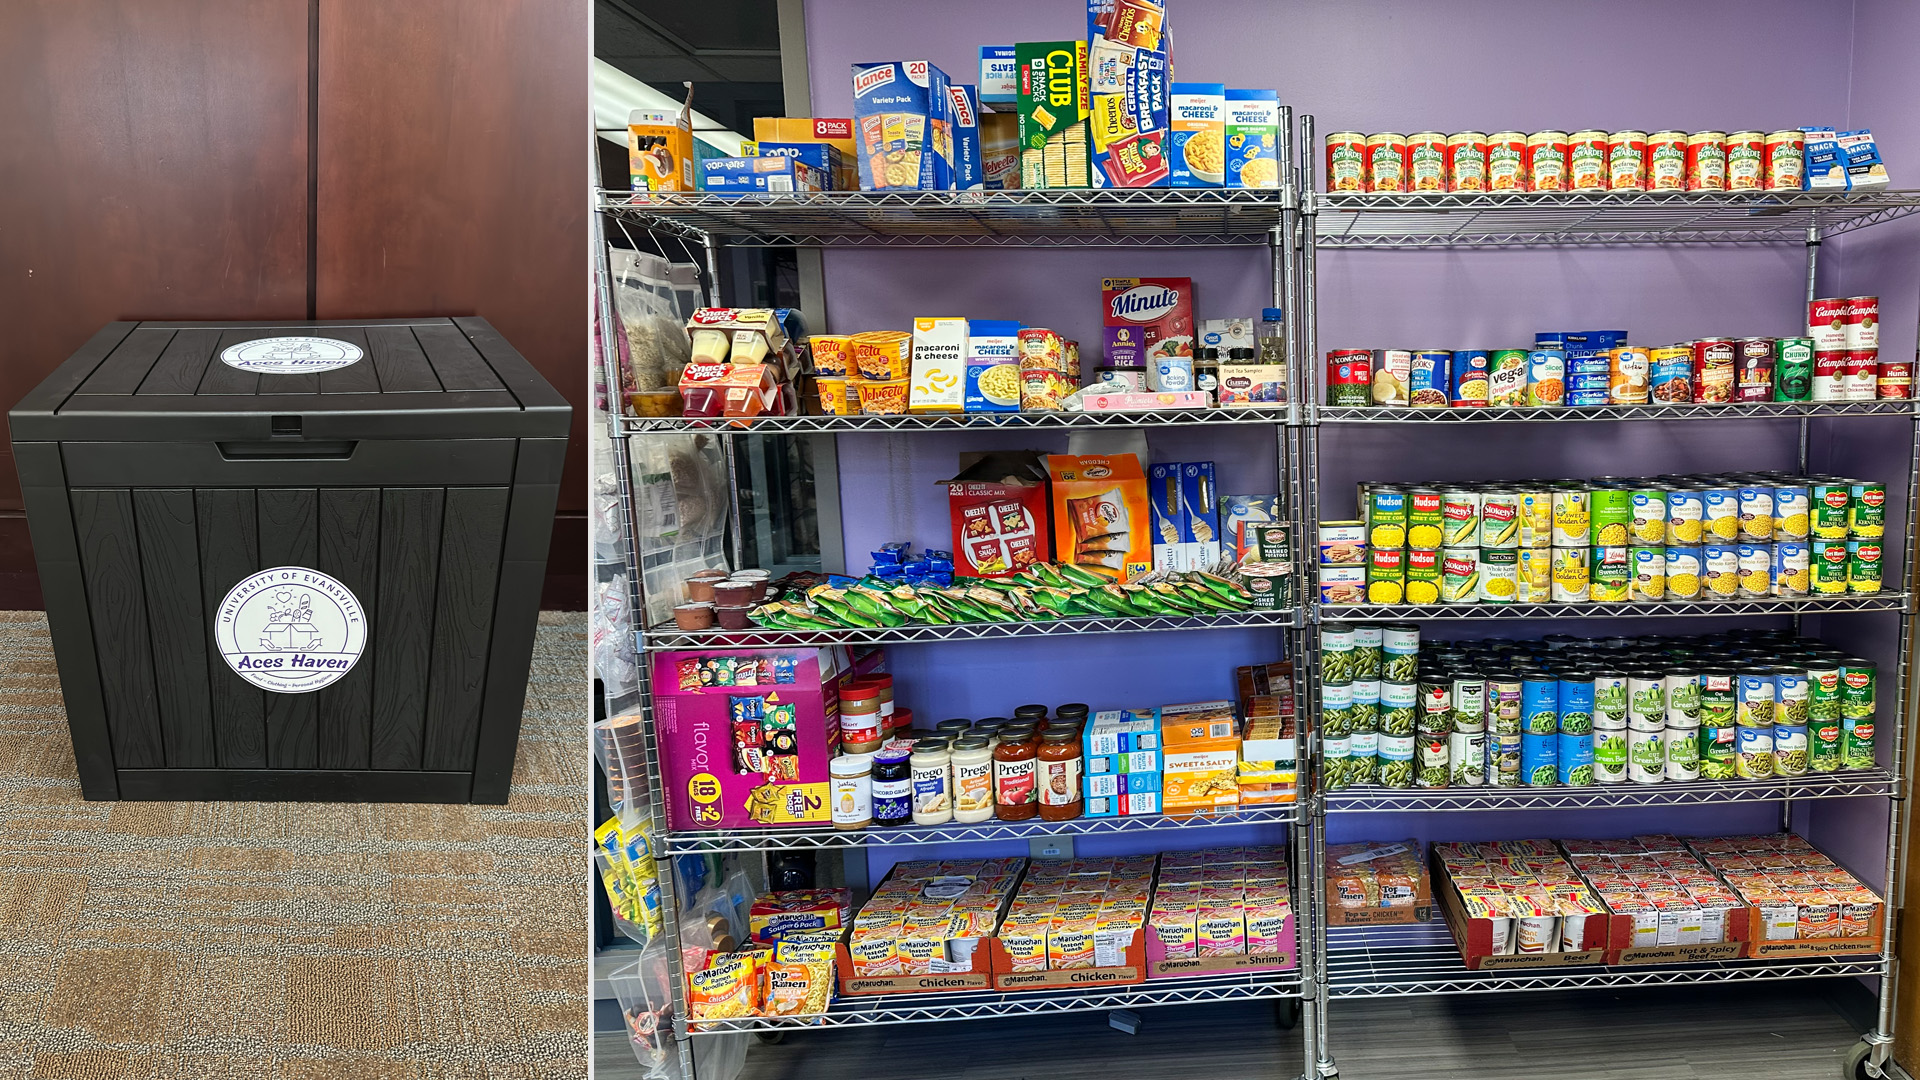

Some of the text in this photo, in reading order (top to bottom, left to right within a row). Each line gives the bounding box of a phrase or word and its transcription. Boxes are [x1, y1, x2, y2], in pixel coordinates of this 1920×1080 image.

[1119, 8, 1135, 41] Cheerios
[910, 63, 926, 74] 20
[1034, 60, 1042, 68] 9
[855, 68, 893, 91] Lance
[1046, 50, 1073, 107] CLUB
[1078, 46, 1088, 110] FAMILY SIZE
[1032, 71, 1040, 103] STACKS
[1038, 71, 1046, 101] SNACK
[1128, 71, 1136, 112] CEREAL
[1138, 52, 1154, 131] BREAKFAST
[1151, 71, 1164, 111] PACK
[951, 88, 971, 126] Lance
[1107, 97, 1118, 134] Cheerios
[1182, 111, 1215, 119] CHEESE
[817, 121, 827, 134] 8
[743, 146, 755, 155] 12
[962, 137, 971, 162] Variety
[1809, 143, 1834, 152] SNACK
[1845, 144, 1872, 155] SNACK
[1118, 147, 1136, 174] Lucky
[1128, 142, 1147, 173] Charms
[1113, 289, 1178, 317] Minute
[696, 308, 737, 318] Snack
[1600, 335, 1605, 343] 6
[1706, 351, 1733, 361] CHUNKY
[687, 364, 727, 374] Snack
[861, 385, 903, 402] Velveeta
[1492, 384, 1515, 394] Original
[1377, 497, 1403, 506] Hudson
[1414, 498, 1439, 507] Hudson
[1484, 505, 1516, 517] Stokely's
[1374, 554, 1400, 563] Hudson
[1410, 554, 1434, 563] Hudson
[223, 572, 359, 623] UNIVERSITY OF EVANSVILLE
[238, 654, 348, 669] Aces Haven
[694, 722, 709, 771] flavor
[999, 762, 1034, 776] Prego
[1206, 759, 1233, 767] SALTY
[913, 768, 943, 781] Prego
[960, 763, 990, 778] Prego
[1004, 777, 1029, 785] Traditional
[699, 780, 716, 795] 18
[793, 789, 804, 818] FREE
[805, 795, 822, 810] 2
[702, 804, 721, 821] +2
[777, 913, 816, 921] Maruchan
[768, 924, 793, 933] Souper
[861, 939, 896, 951] Maruchan
[1215, 940, 1235, 948] Shrimp
[1710, 946, 1737, 954] Spicy
[864, 948, 889, 957] Instant
[702, 962, 742, 978] Maruchan
[711, 975, 731, 984] Ramen
[771, 972, 789, 981] Top
[702, 983, 724, 992] Noodle
[772, 981, 806, 989] Ramen
[919, 978, 965, 988] Chicken
[709, 991, 732, 1004] Chicken
